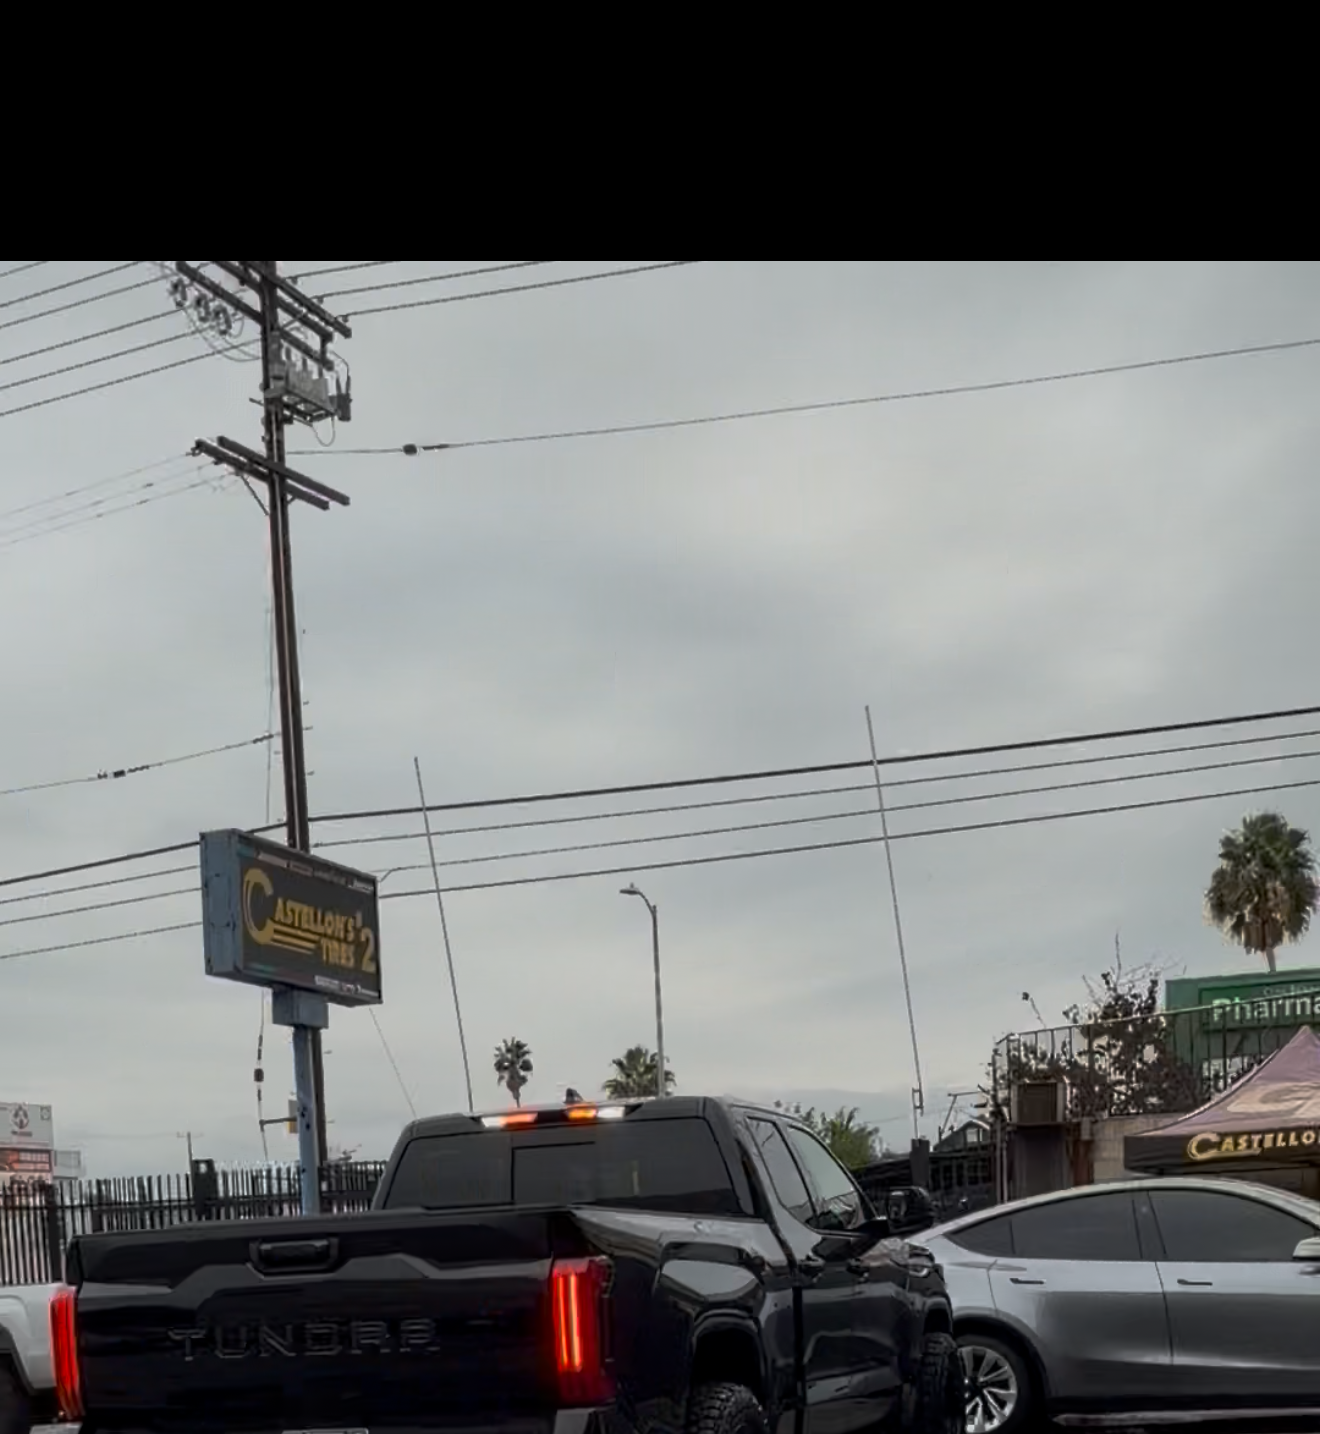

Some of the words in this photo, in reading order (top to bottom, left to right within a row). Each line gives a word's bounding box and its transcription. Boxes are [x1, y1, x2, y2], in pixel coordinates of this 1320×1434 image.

[320, 937, 355, 968] TIRES
[1187, 1130, 1320, 1162] CASTELLO
[168, 1317, 441, 1361] TUNDRA
